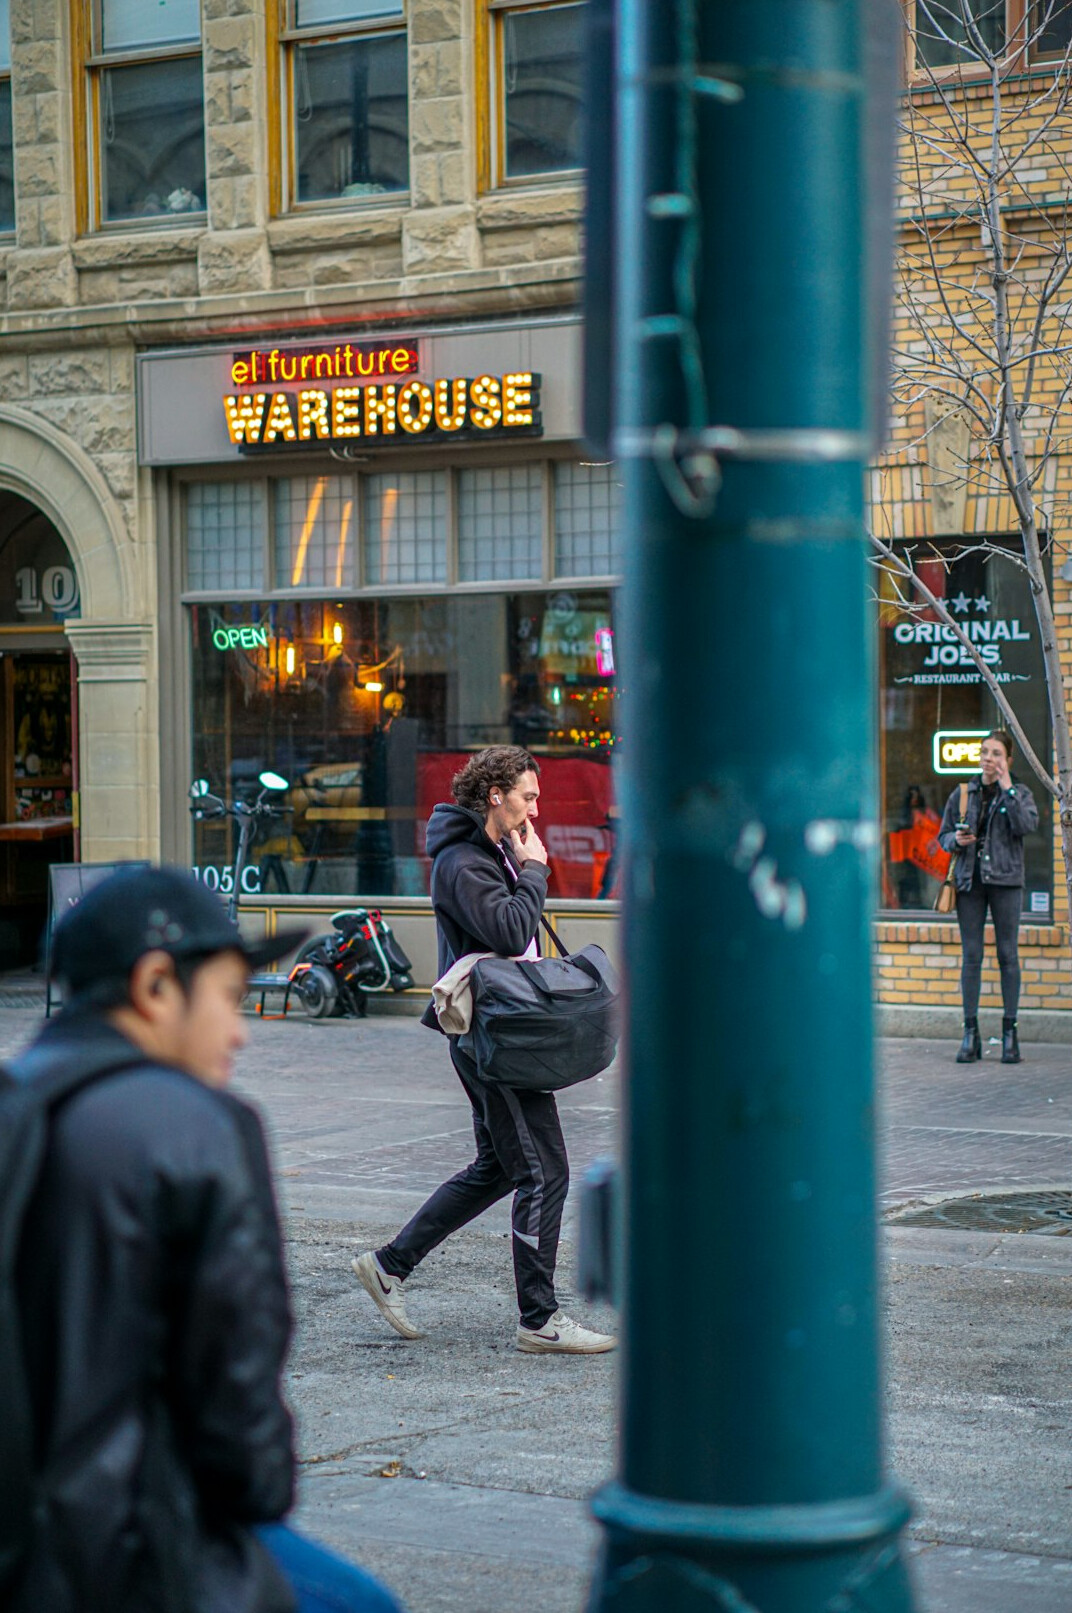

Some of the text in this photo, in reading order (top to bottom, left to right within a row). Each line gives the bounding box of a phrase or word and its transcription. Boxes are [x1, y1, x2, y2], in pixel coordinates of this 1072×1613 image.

[231, 345, 410, 383] el furniture
[223, 372, 534, 443] WAREHOUSE
[213, 627, 268, 650] OPEN
[914, 672, 1010, 684] RESTAURANT AR
[942, 742, 982, 762] OPE
